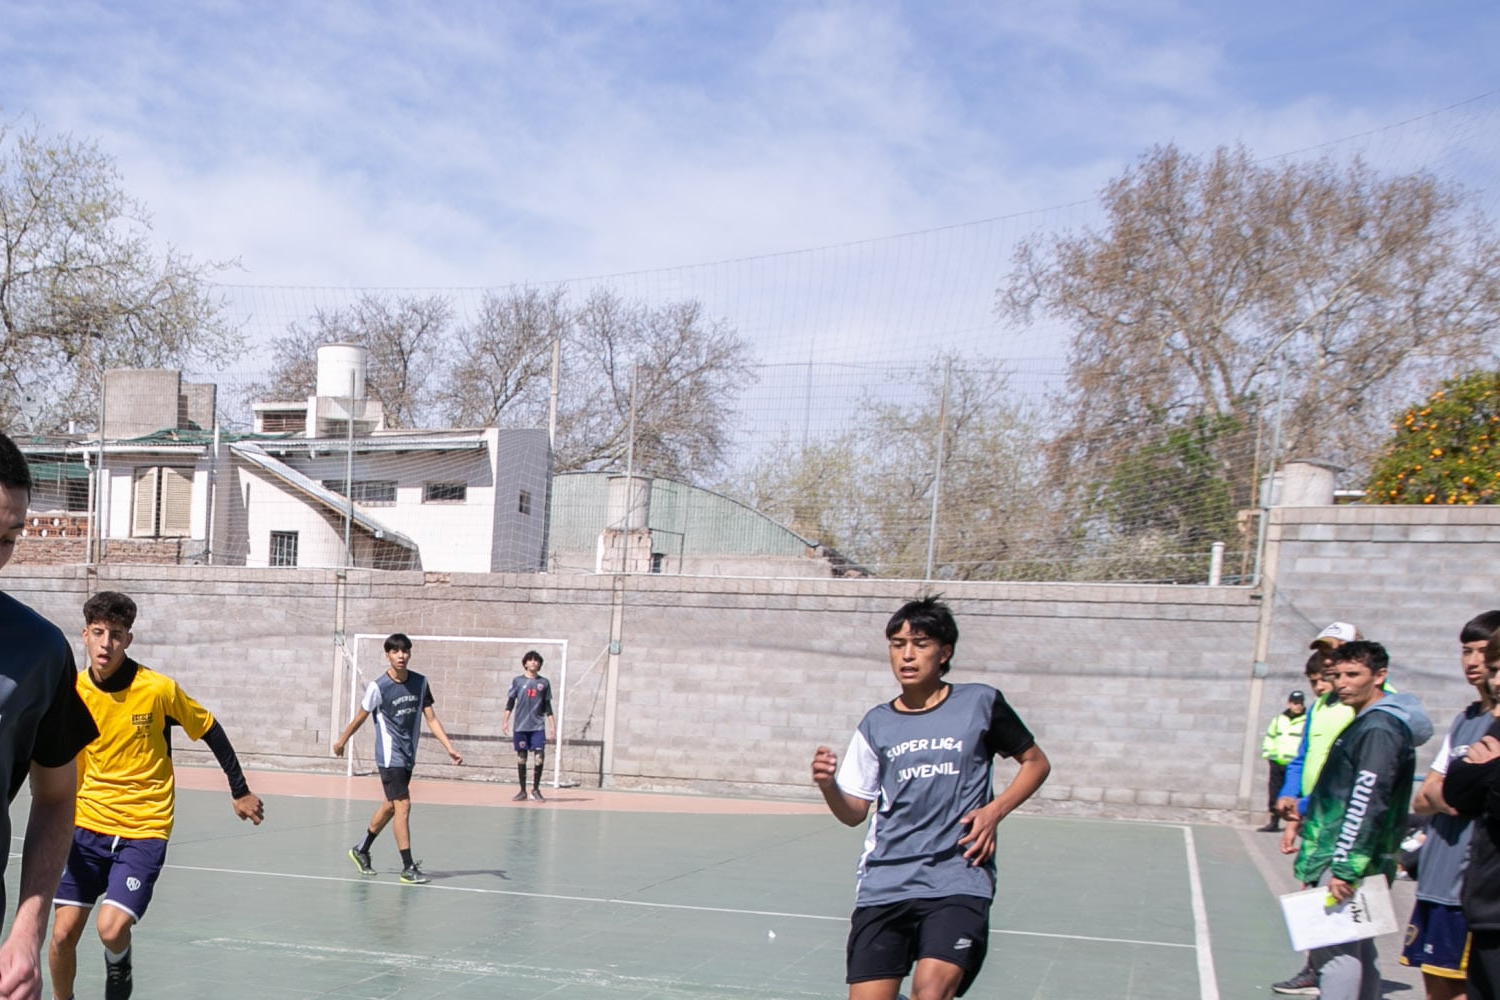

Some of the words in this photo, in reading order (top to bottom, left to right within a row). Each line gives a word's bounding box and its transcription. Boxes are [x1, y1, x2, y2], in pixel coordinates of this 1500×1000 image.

[887, 739, 929, 762] SUPER
[931, 737, 963, 752] LIGA
[897, 762, 960, 783] JUVENIL
